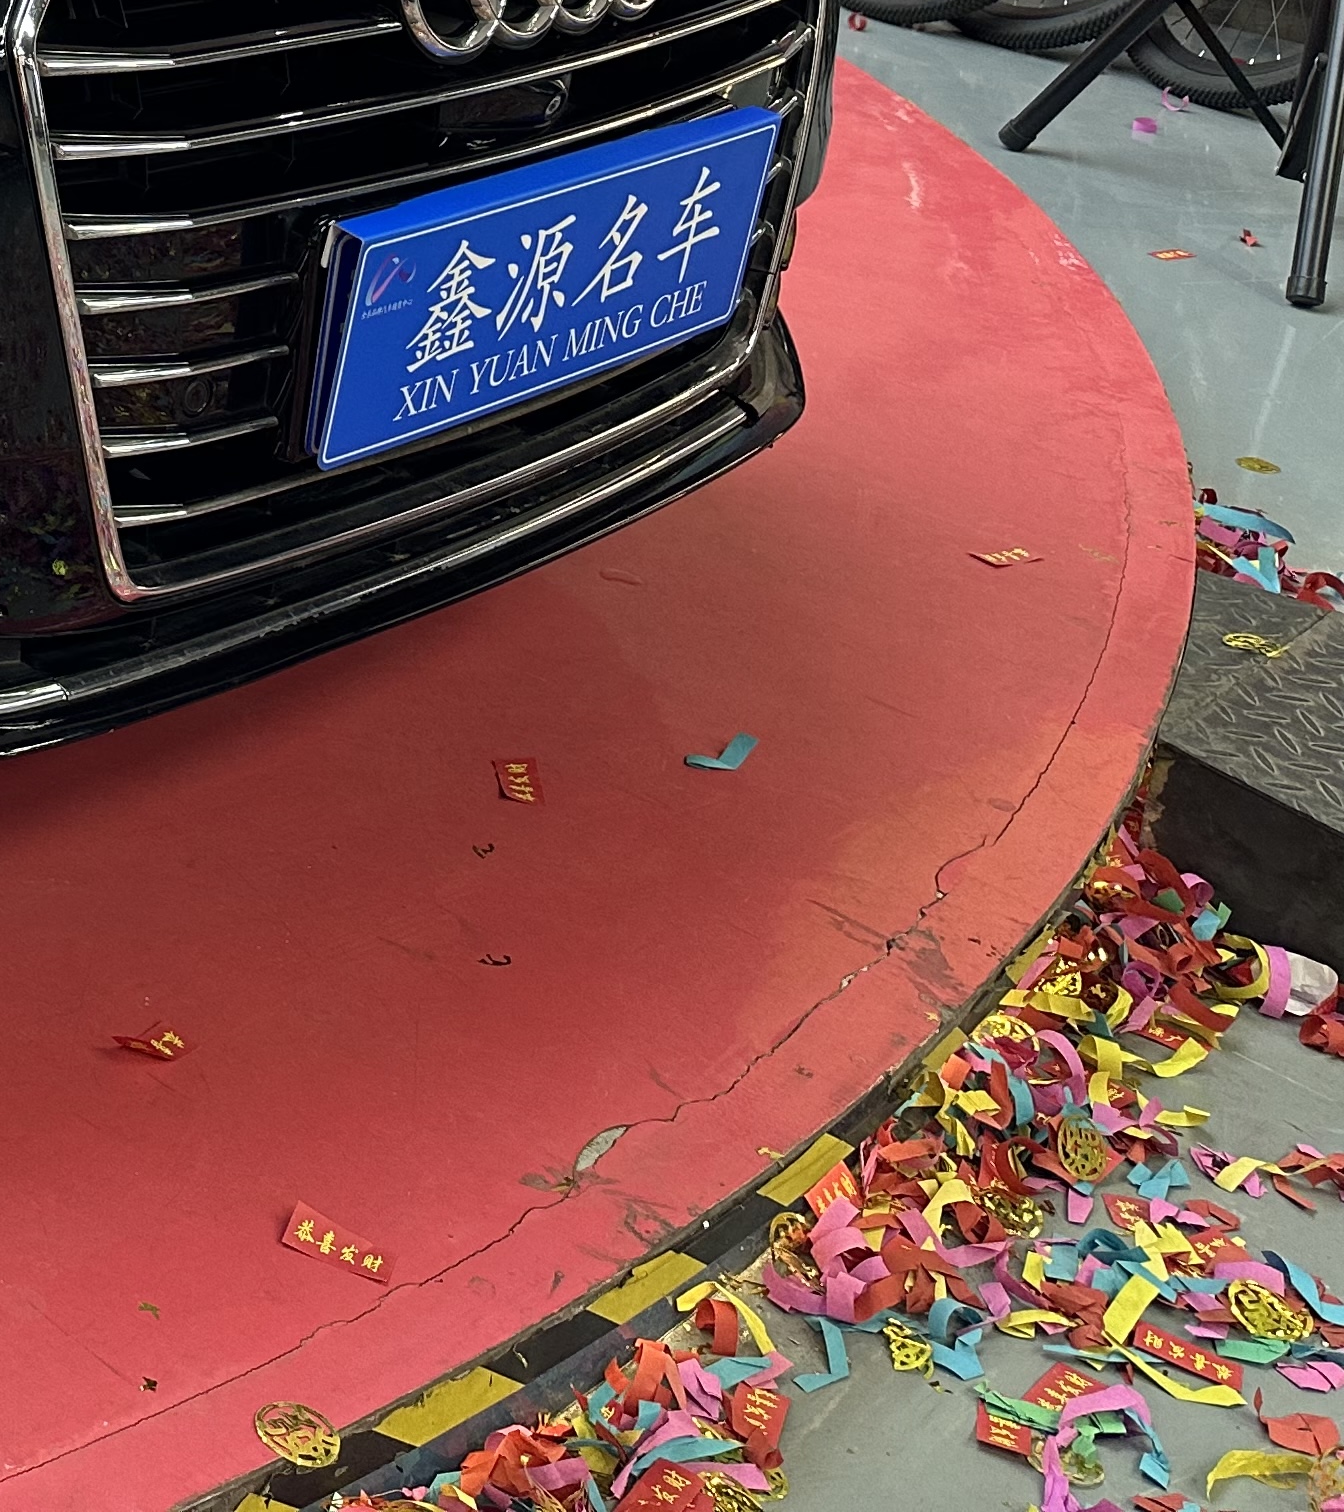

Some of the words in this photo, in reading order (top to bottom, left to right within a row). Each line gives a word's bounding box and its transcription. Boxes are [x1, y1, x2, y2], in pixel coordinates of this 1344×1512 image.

[404, 165, 722, 374] 鑫源名车
[392, 370, 461, 422] XIN
[467, 334, 559, 396] YUAN
[562, 304, 644, 361] MING
[648, 279, 709, 329] CHE
[293, 1219, 384, 1273] 恭喜发财
[1142, 1330, 1234, 1382] 恭喜发财
